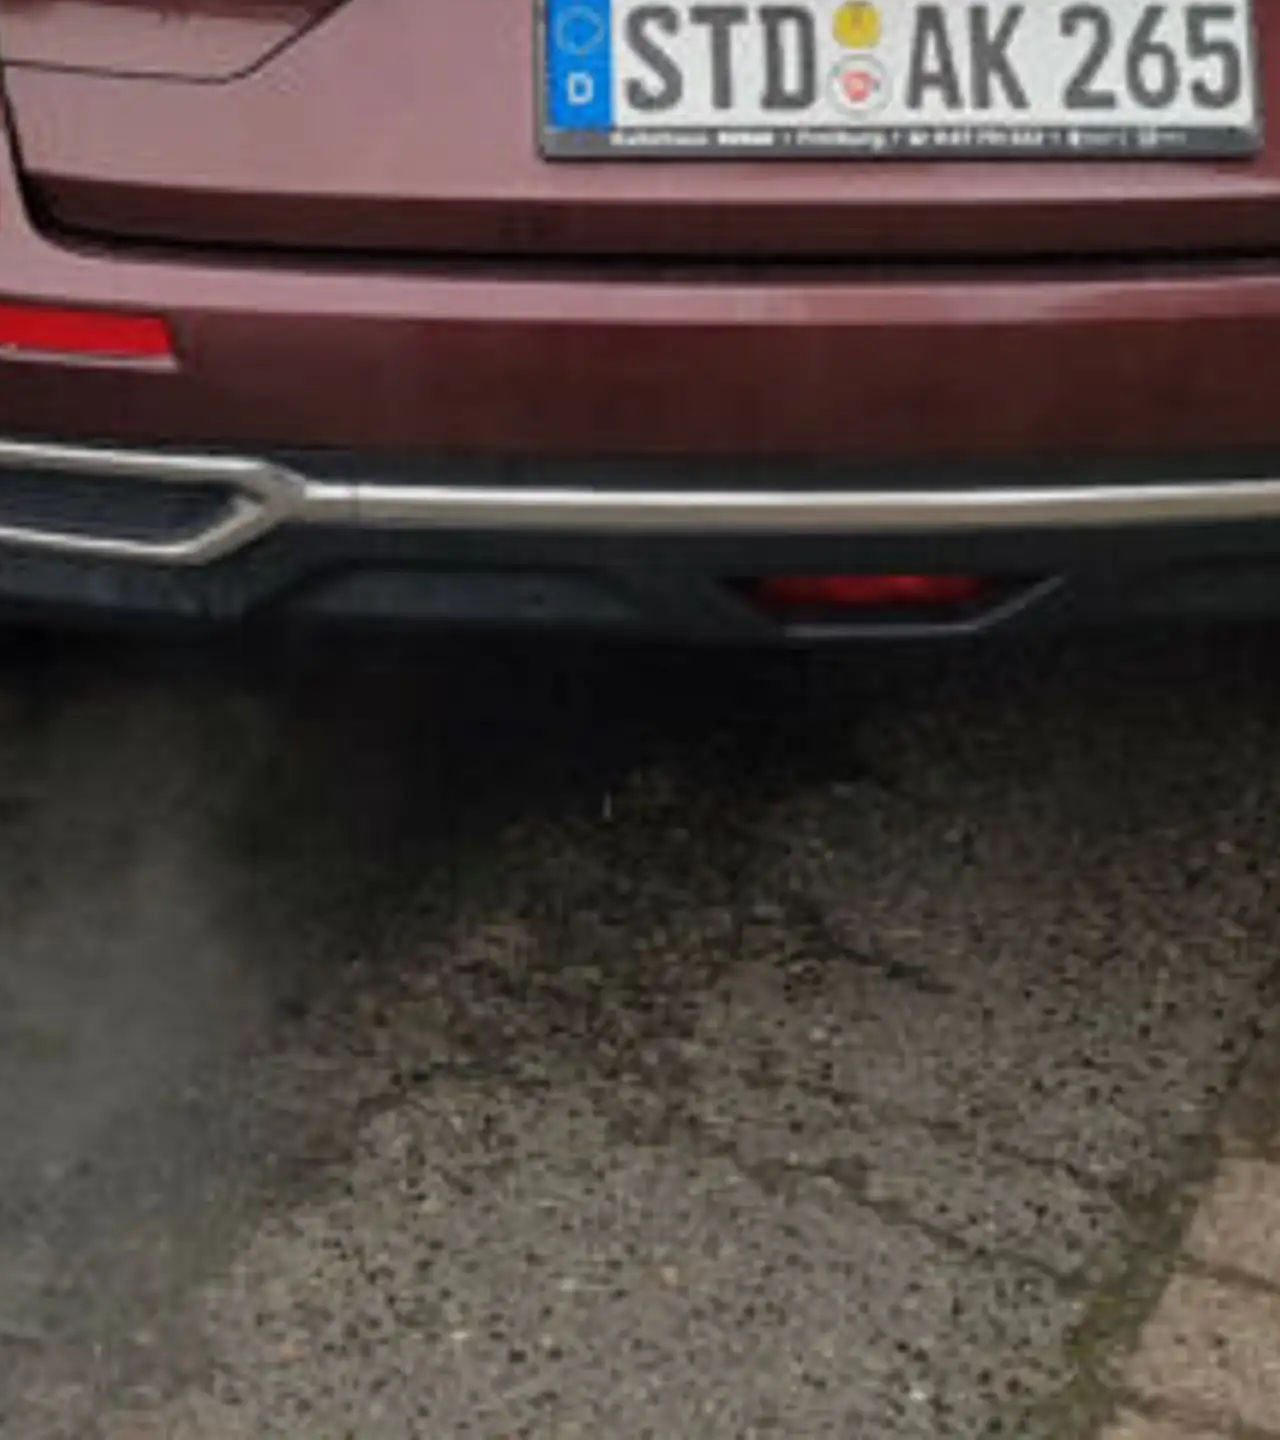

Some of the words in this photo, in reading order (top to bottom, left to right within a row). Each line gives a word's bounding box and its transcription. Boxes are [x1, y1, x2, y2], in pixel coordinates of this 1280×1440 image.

[566, 71, 594, 105] D
[624, 2, 818, 111] STD
[904, 2, 1030, 111] AK
[1058, 1, 1242, 111] 265
